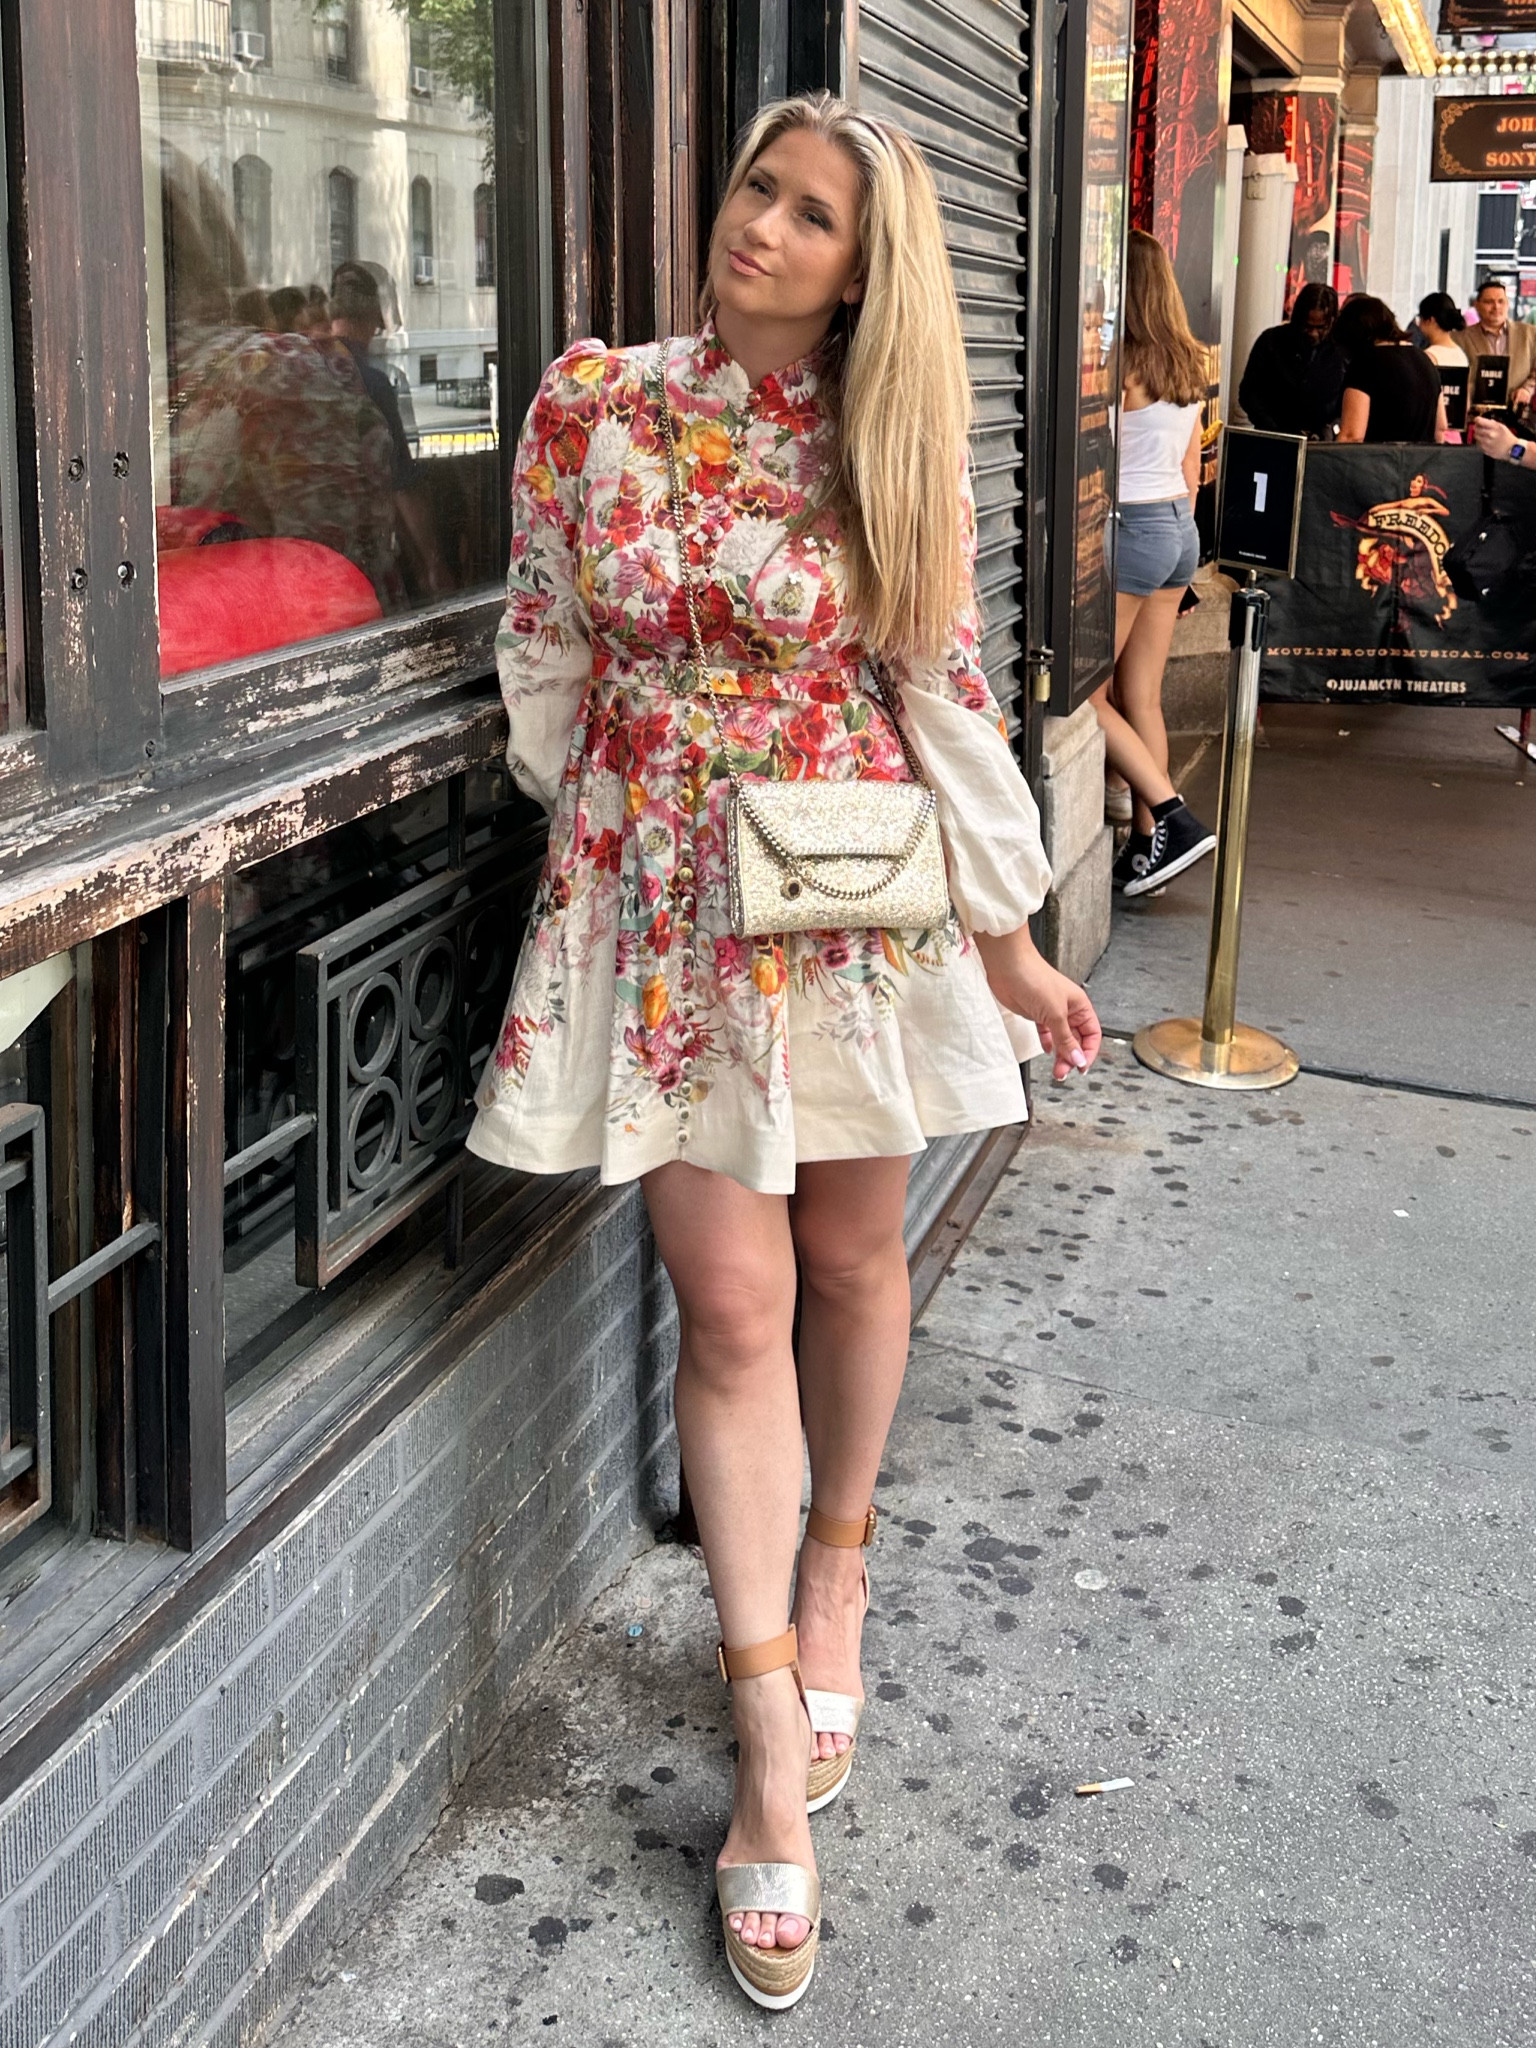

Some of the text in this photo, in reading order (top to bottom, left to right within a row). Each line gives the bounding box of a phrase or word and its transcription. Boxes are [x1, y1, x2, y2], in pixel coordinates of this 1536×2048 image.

[1496, 117, 1536, 133] JOH
[1481, 370, 1503, 379] TABLE
[1440, 385, 1460, 395] BLE
[1253, 471, 1268, 513] 1
[1372, 513, 1447, 574] FREEDO
[1267, 648, 1529, 660] MOULINROUGEMUSICAL.COM
[1338, 679, 1467, 693] JUJAMCYN THEATERS
